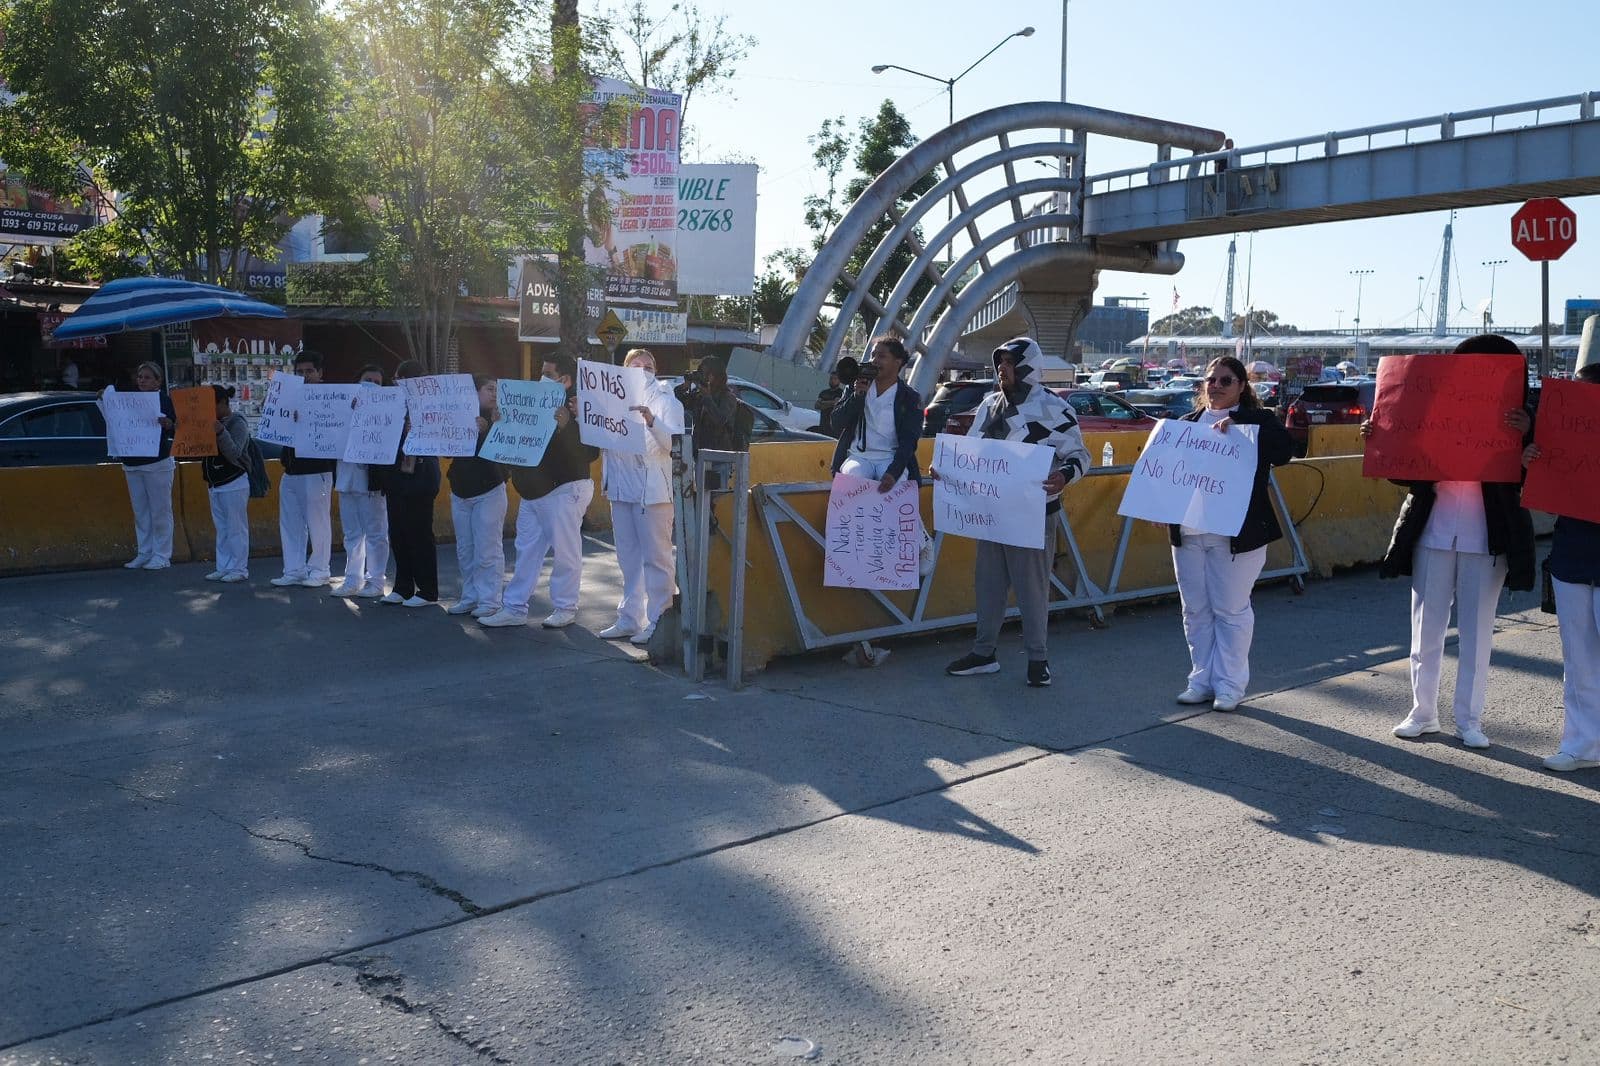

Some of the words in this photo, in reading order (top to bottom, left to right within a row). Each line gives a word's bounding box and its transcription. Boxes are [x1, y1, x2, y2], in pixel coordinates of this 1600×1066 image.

[3, 209, 34, 217] COMO:
[35, 212, 65, 221] CRUSA
[28, 220, 42, 230] 619
[43, 222, 57, 231] 512
[58, 223, 79, 233] 6447
[1516, 217, 1573, 242] ALTO
[249, 274, 271, 289] 632
[580, 366, 597, 391] NO
[1174, 425, 1241, 461] AMARILLAS
[938, 440, 1012, 476] HOSPITAL
[1171, 458, 1226, 496] CUMPLES
[894, 503, 917, 578] RESPETO
